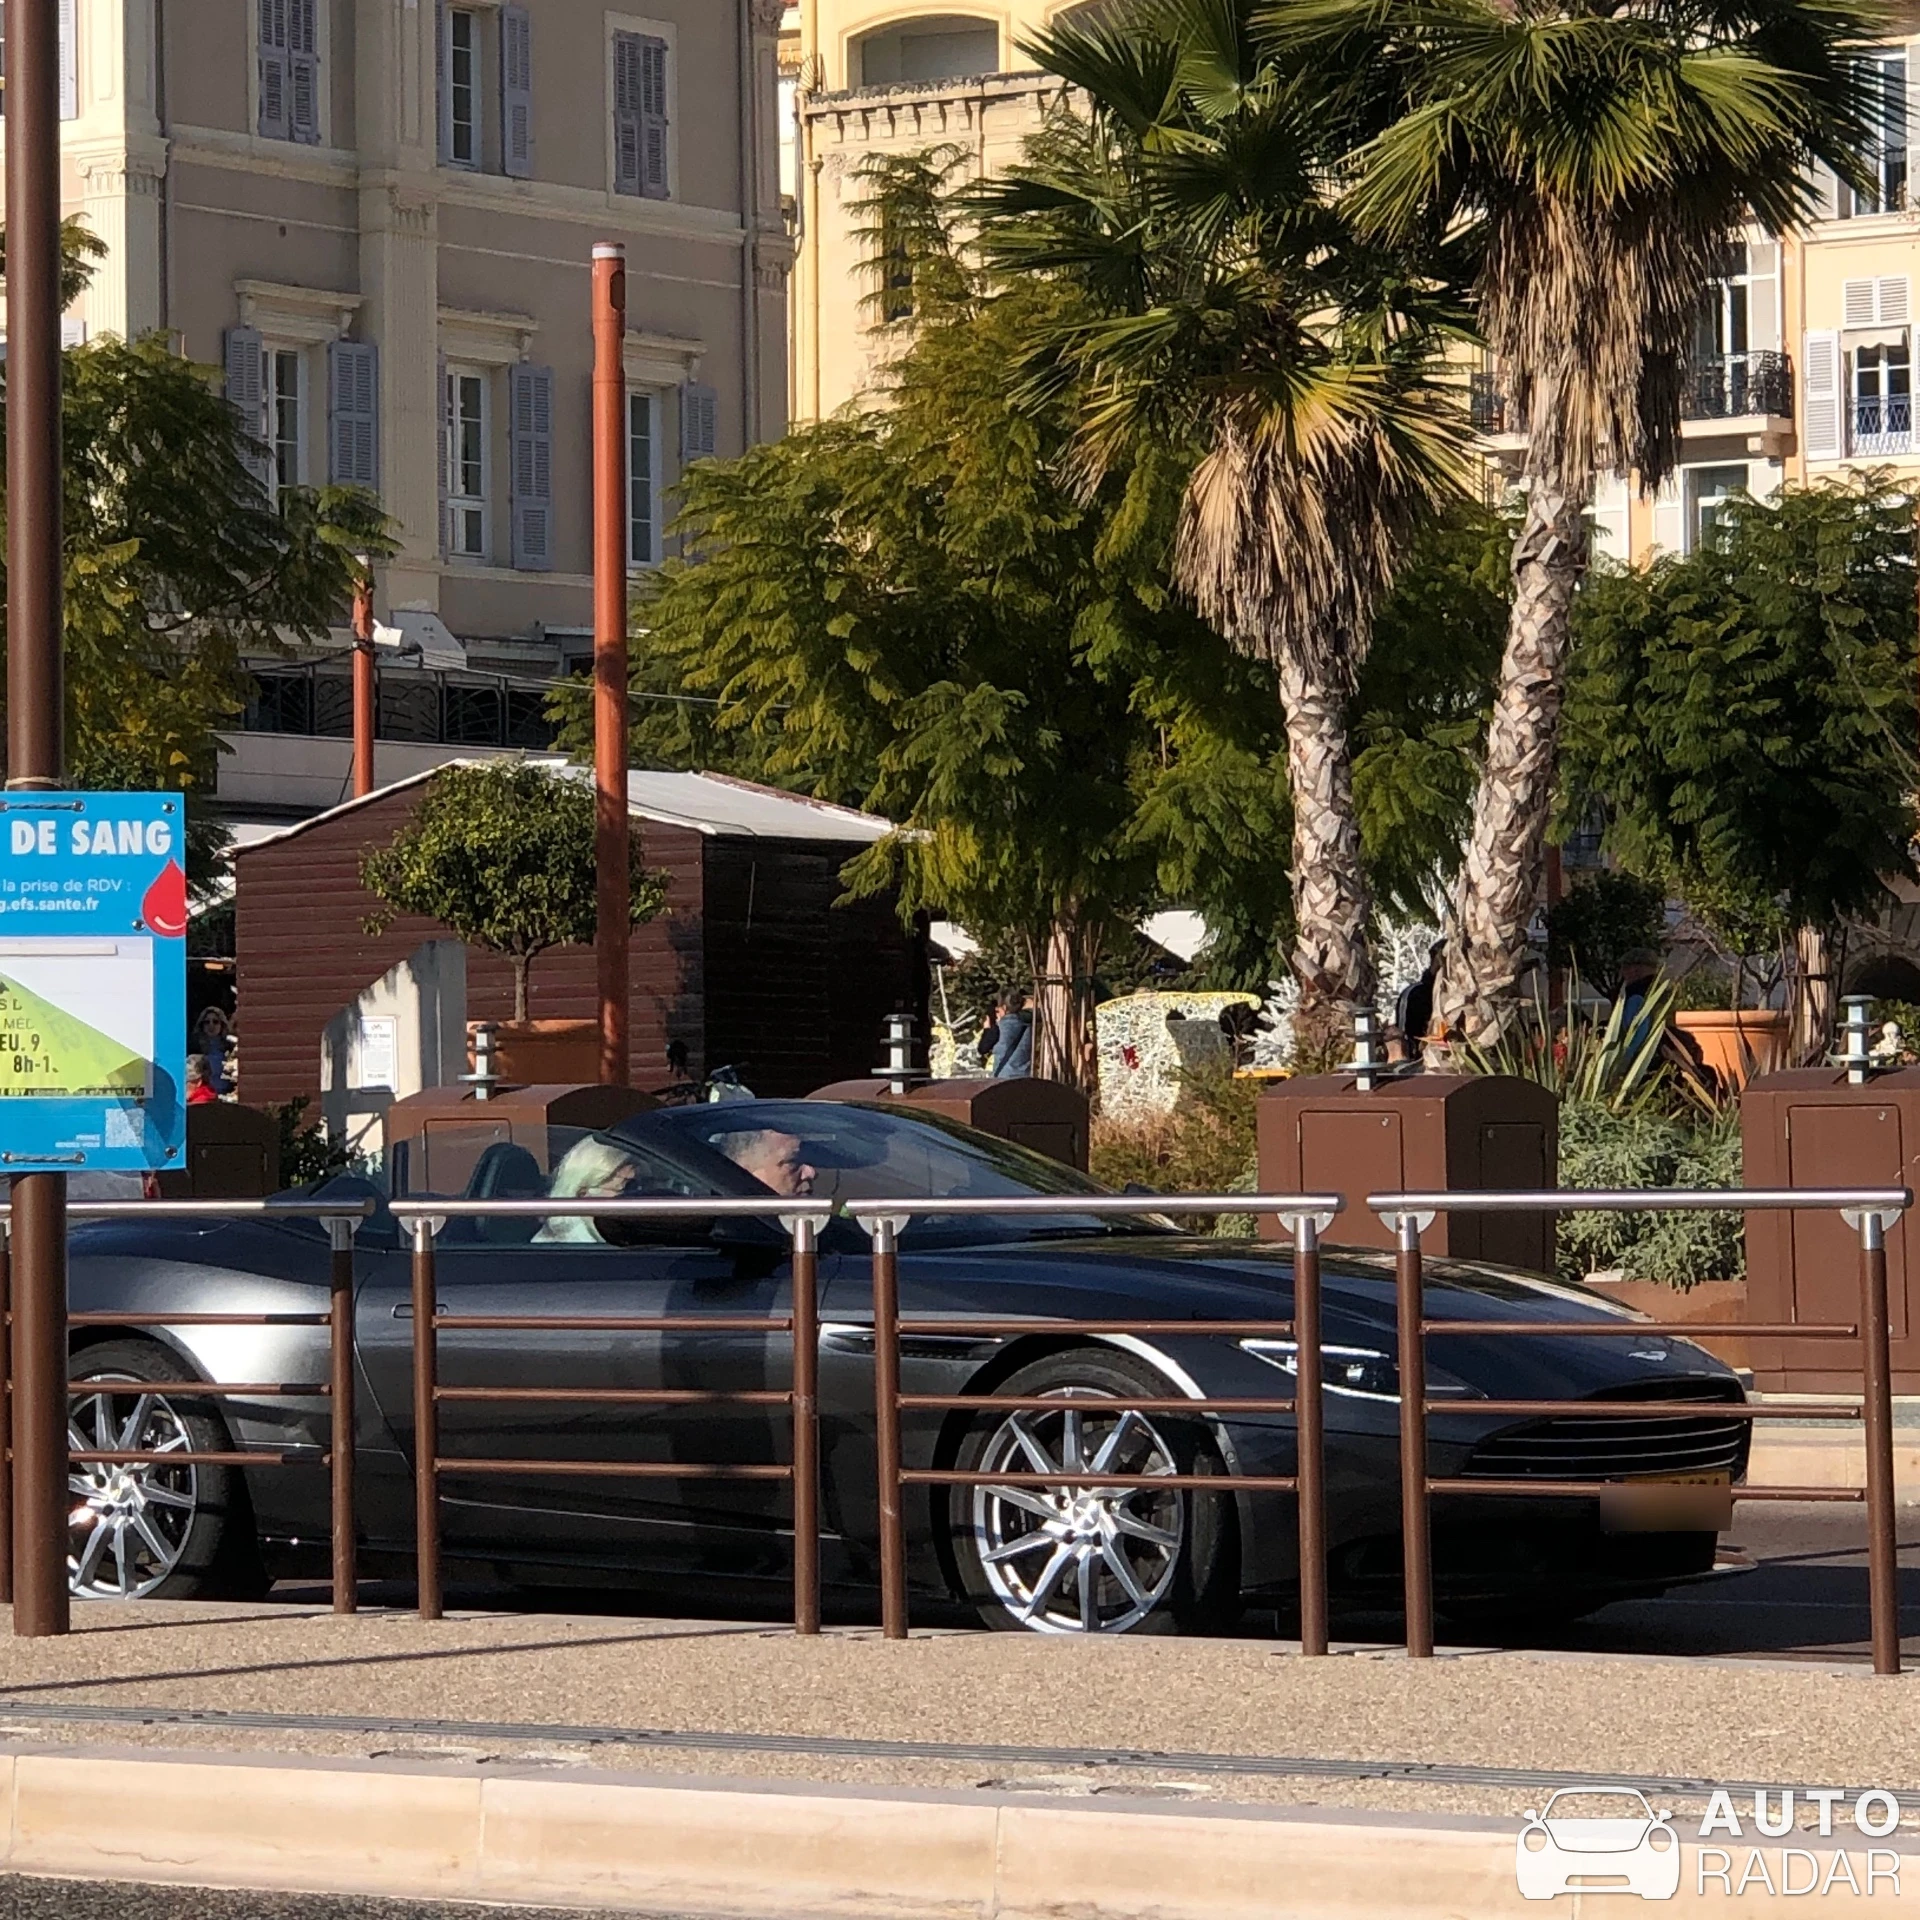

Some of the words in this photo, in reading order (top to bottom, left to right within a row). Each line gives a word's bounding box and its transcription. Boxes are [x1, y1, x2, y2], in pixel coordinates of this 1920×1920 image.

[11, 820, 57, 855] DE
[71, 820, 172, 855] SANG
[2, 879, 16, 892] la
[20, 879, 59, 894] prise
[63, 879, 83, 892] de
[87, 879, 122, 892] RDV
[13, 1054, 59, 1073] 8h-1
